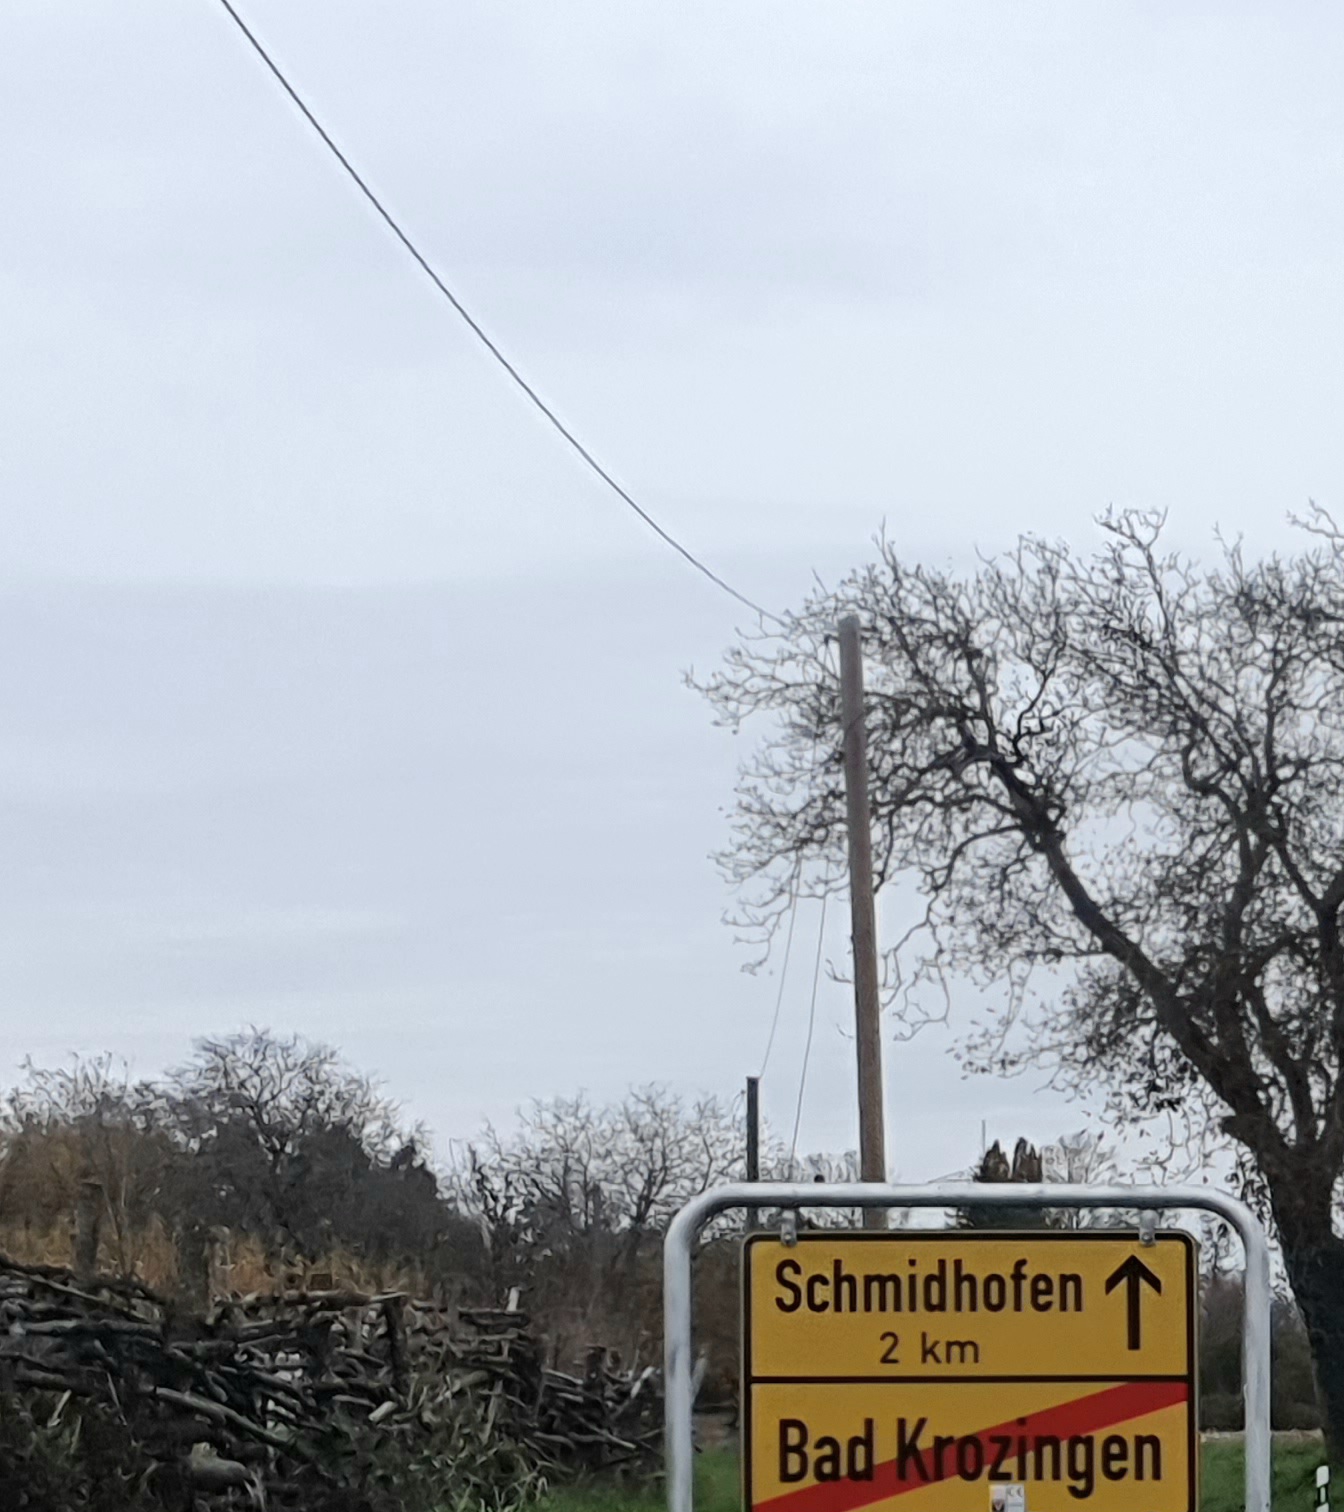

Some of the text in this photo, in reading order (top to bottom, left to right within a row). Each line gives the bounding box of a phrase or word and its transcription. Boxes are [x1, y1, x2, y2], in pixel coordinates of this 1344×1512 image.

[775, 1258, 1083, 1313] Schmidhofen
[879, 1331, 980, 1364] 2 km
[778, 1416, 1162, 1499] Bad Krozingen
